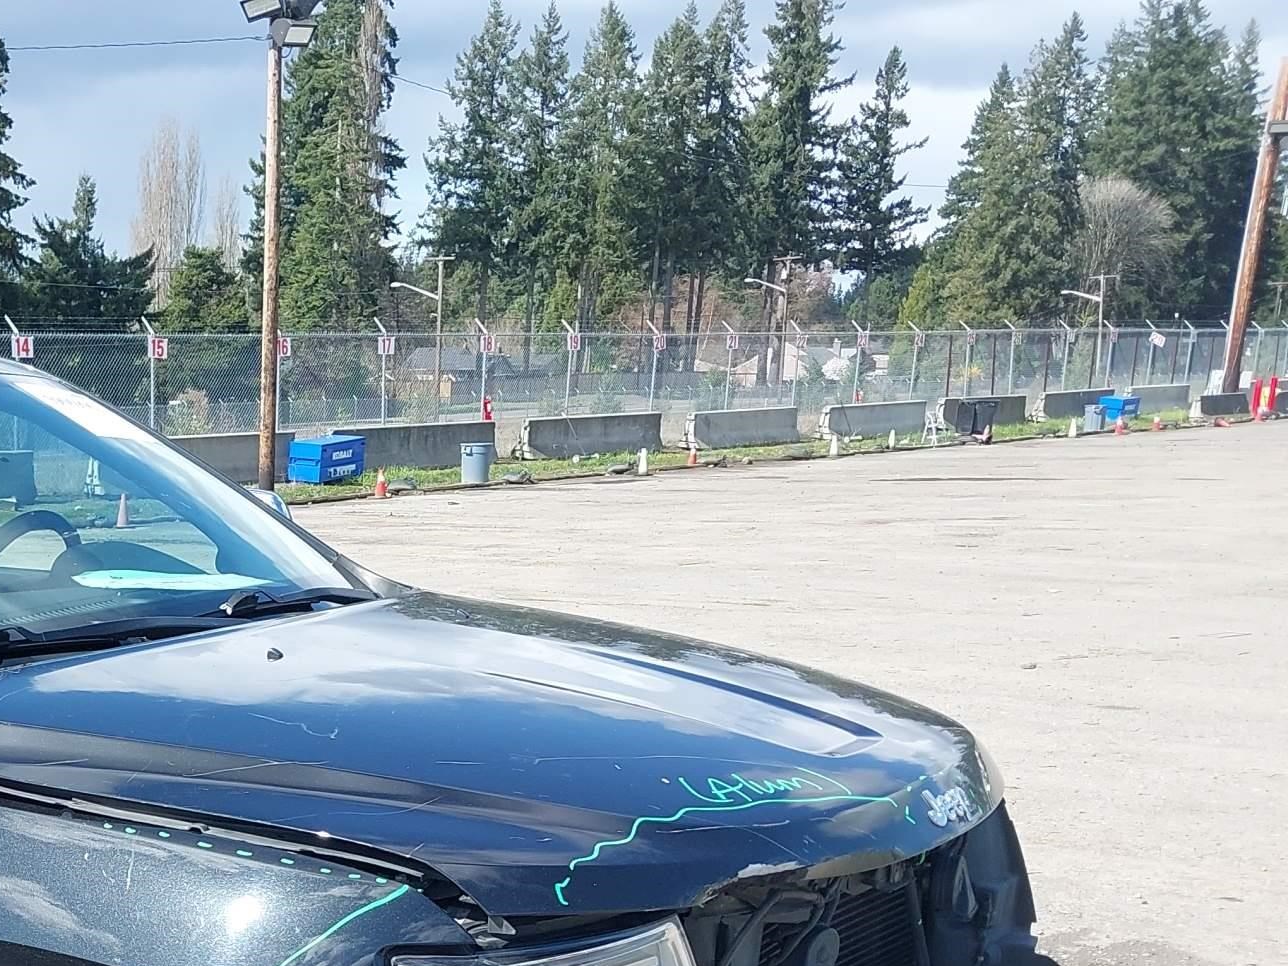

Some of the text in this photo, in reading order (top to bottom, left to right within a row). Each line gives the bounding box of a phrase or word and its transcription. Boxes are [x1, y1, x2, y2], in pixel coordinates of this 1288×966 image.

[15, 337, 30, 356] 14
[151, 339, 165, 357] 15
[382, 338, 392, 353] 17
[482, 335, 493, 349] 18
[569, 335, 579, 349] 19
[655, 335, 665, 350] 20
[728, 335, 737, 349] 21
[921, 787, 974, 827] Jeep
